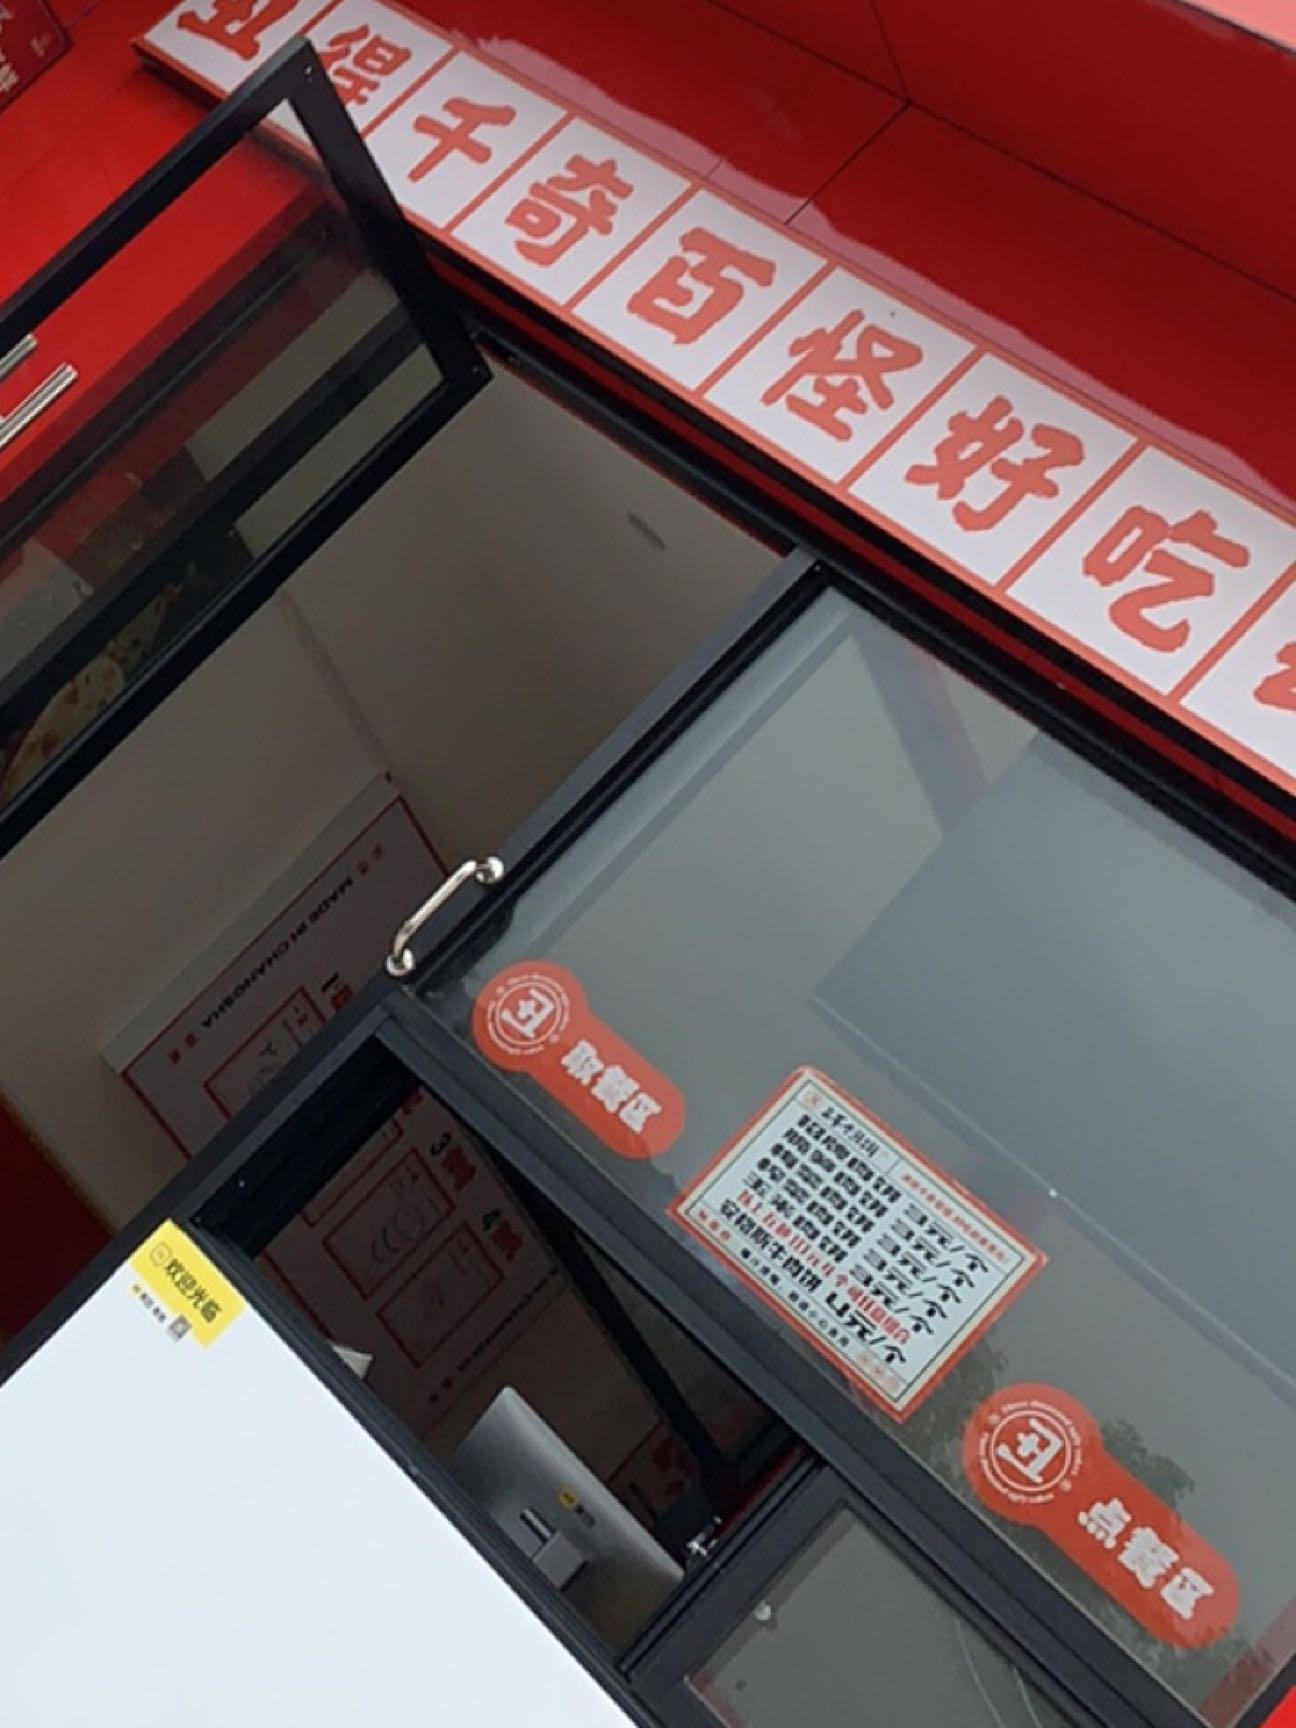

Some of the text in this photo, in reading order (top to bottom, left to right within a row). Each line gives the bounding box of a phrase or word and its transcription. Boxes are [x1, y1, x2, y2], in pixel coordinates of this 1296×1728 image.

[560, 1039, 665, 1135] 取餐区
[164, 1258, 222, 1324] 欢迎光临
[1077, 1497, 1215, 1620] 点餐区
